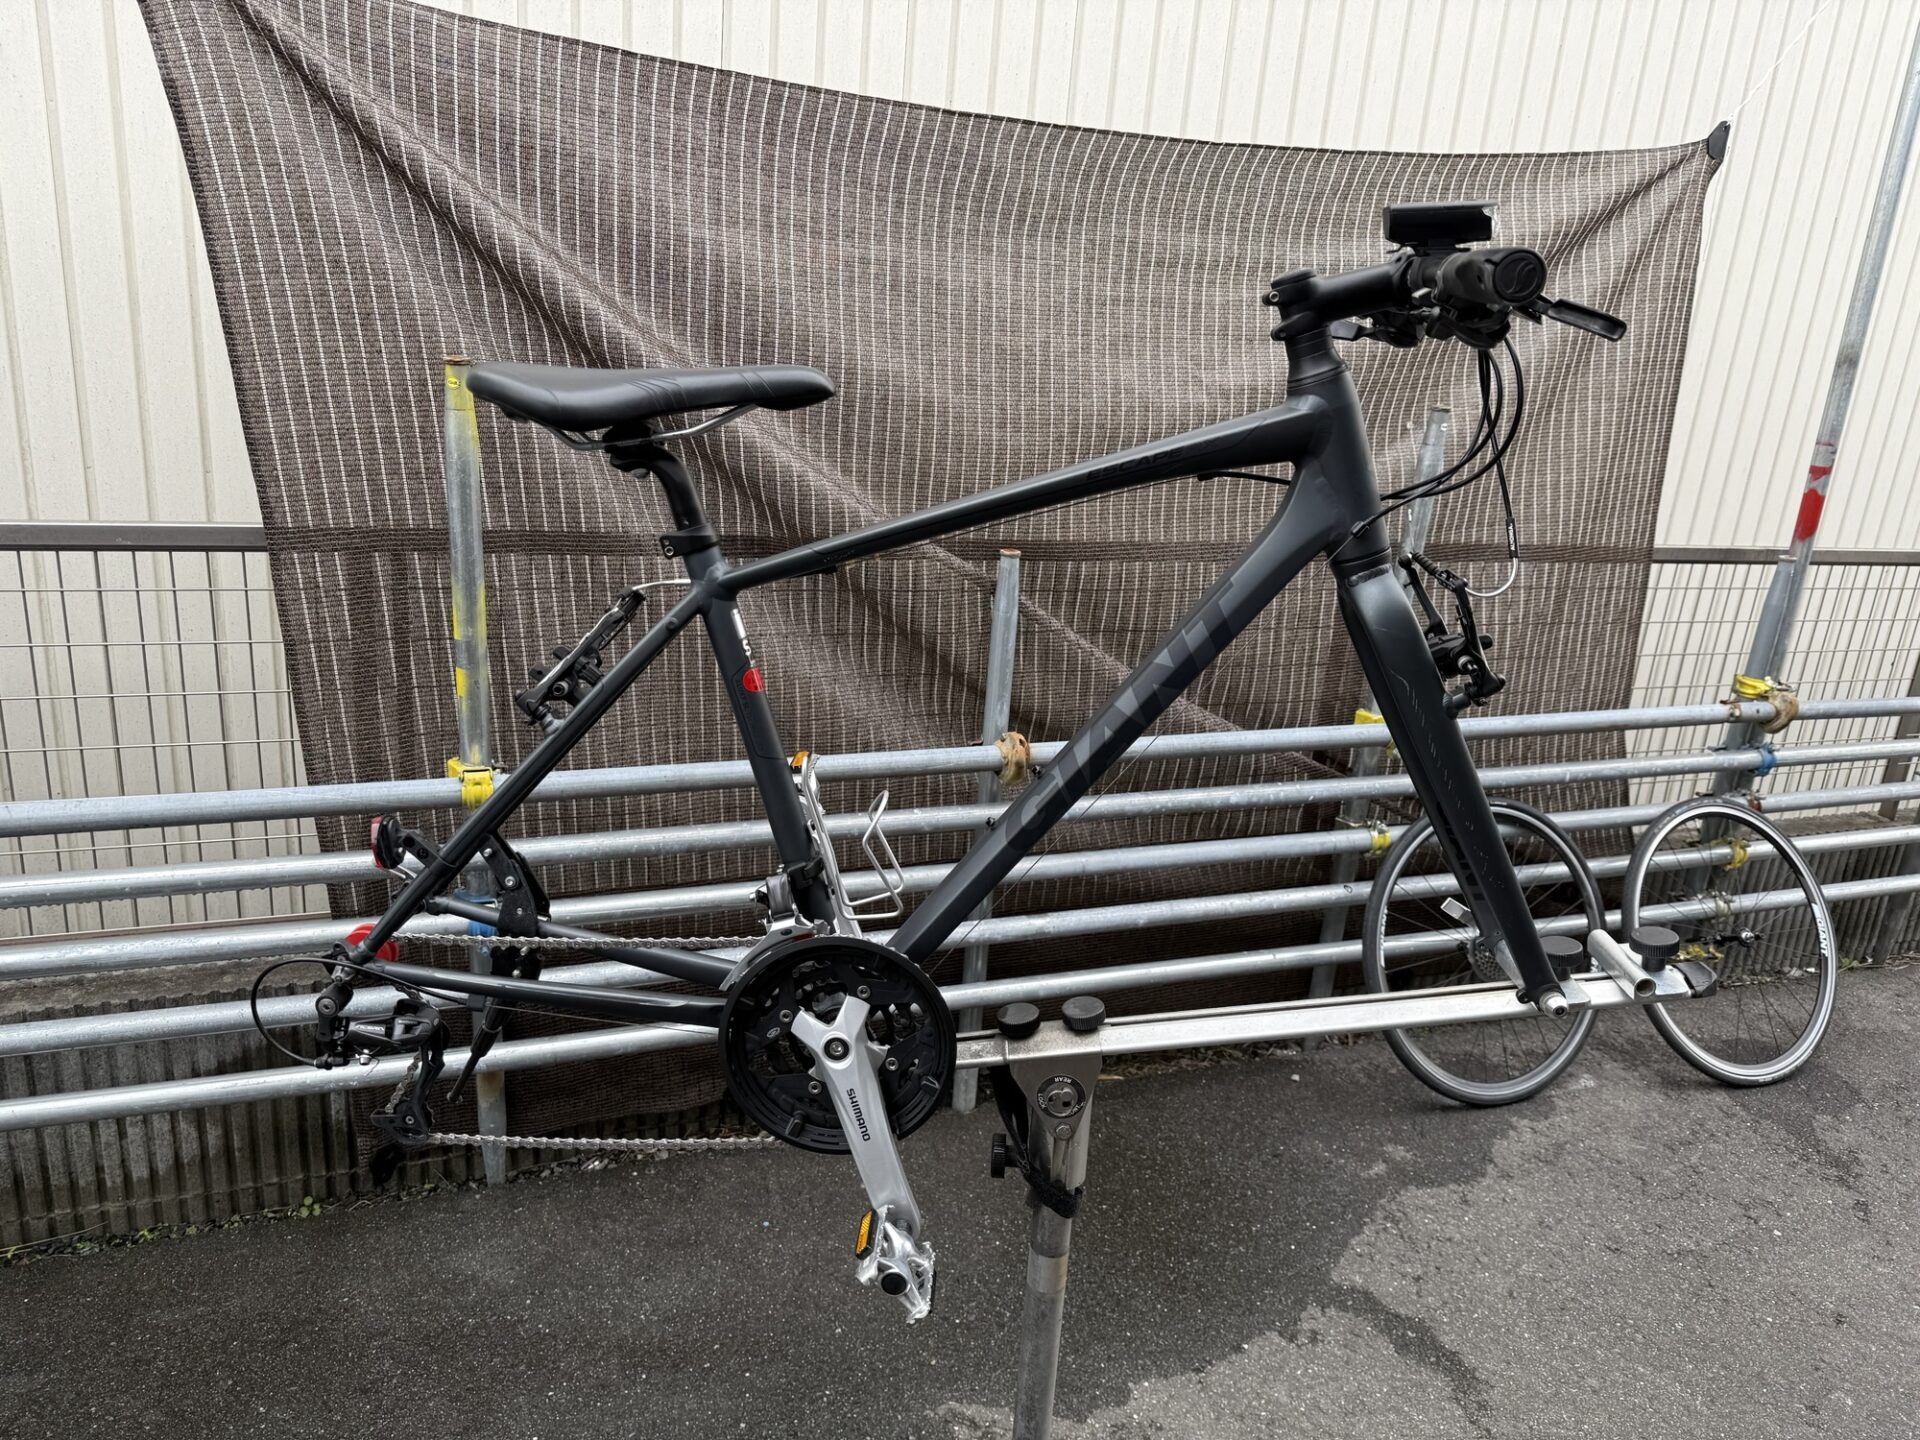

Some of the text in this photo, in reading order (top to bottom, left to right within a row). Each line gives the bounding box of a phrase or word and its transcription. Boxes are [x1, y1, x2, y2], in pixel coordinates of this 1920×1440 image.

[1086, 447, 1184, 481] ESCAPE
[1004, 578, 1234, 856] GIANT
[846, 1088, 871, 1142] SHIMANO
